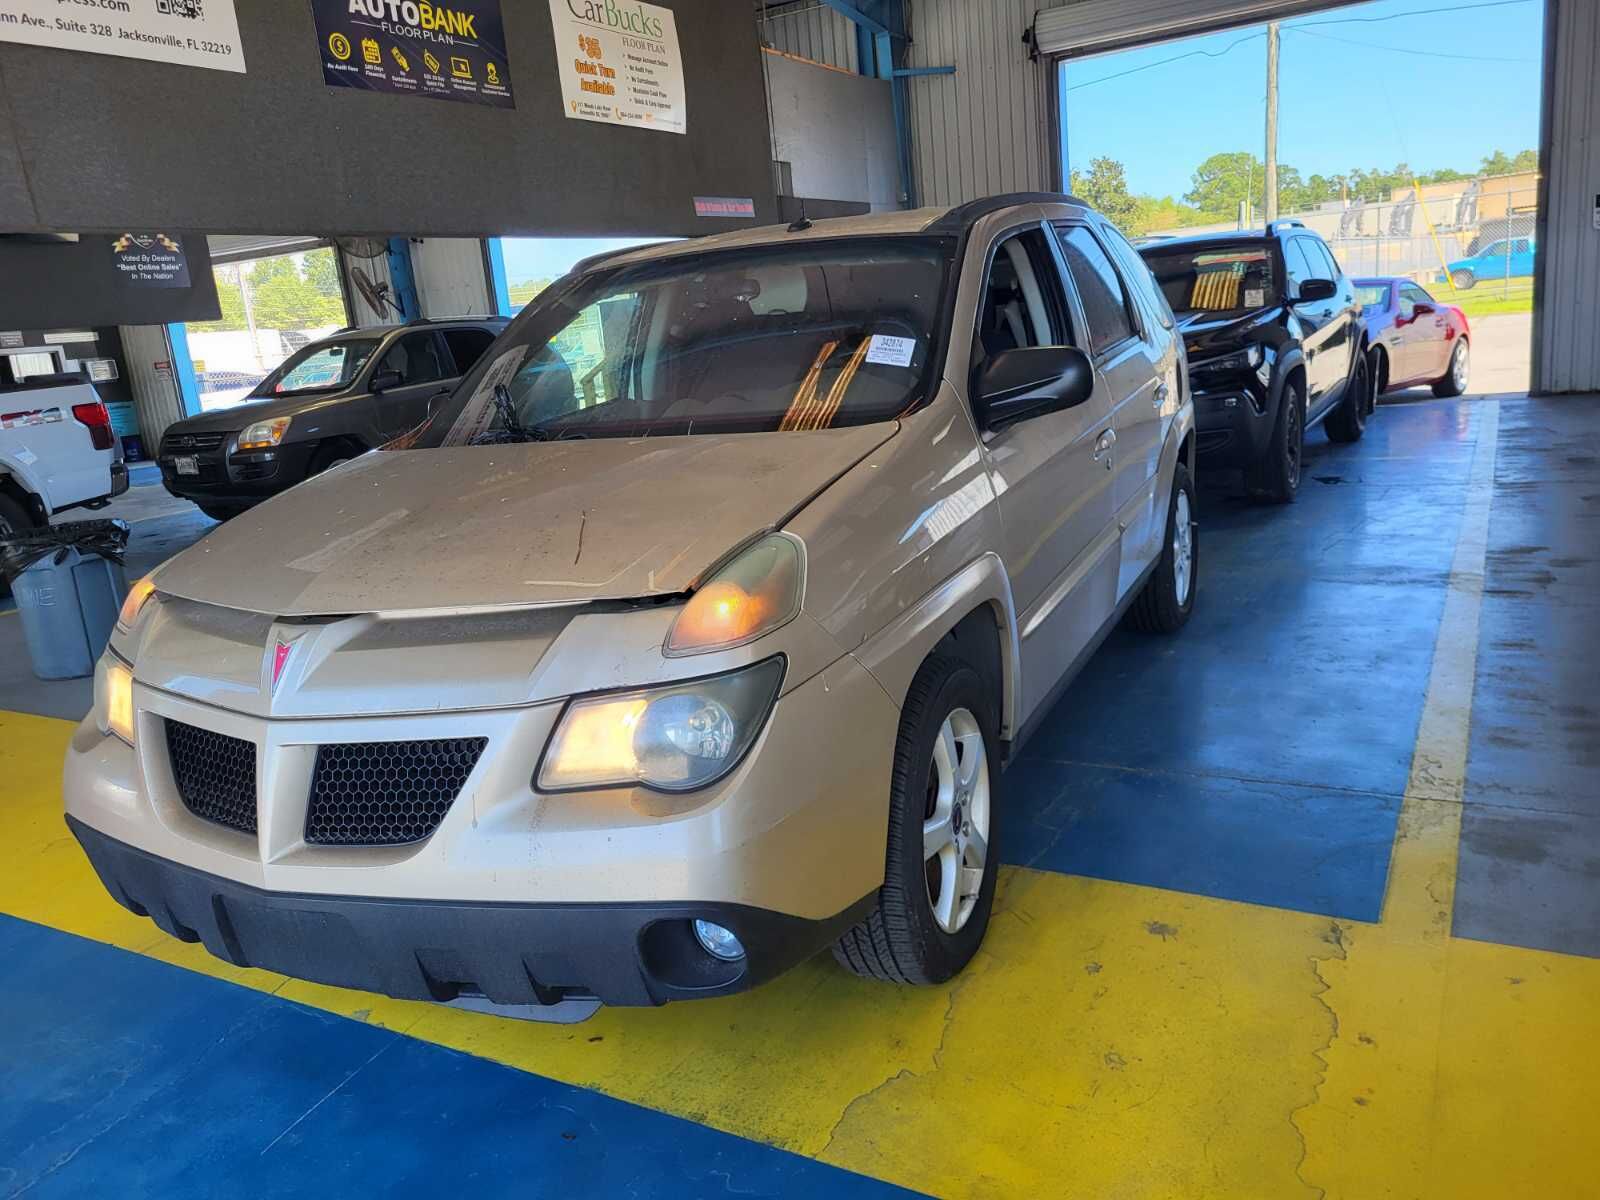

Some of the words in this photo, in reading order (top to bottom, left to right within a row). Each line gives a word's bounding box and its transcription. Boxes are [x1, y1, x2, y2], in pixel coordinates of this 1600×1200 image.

[348, 0, 478, 39] AUTOBANK
[567, 0, 663, 38] CarBucks
[21, 13, 53, 30] Ave.,
[56, 18, 87, 33] Suite
[90, 23, 112, 37] 328
[118, 27, 185, 49] Jacksonville,
[186, 38, 199, 51] FL
[201, 40, 232, 55] 32219
[622, 37, 647, 50] FLOOR
[647, 42, 666, 55] PLAN
[137, 263, 160, 271] Online
[151, 254, 176, 262] Dealers
